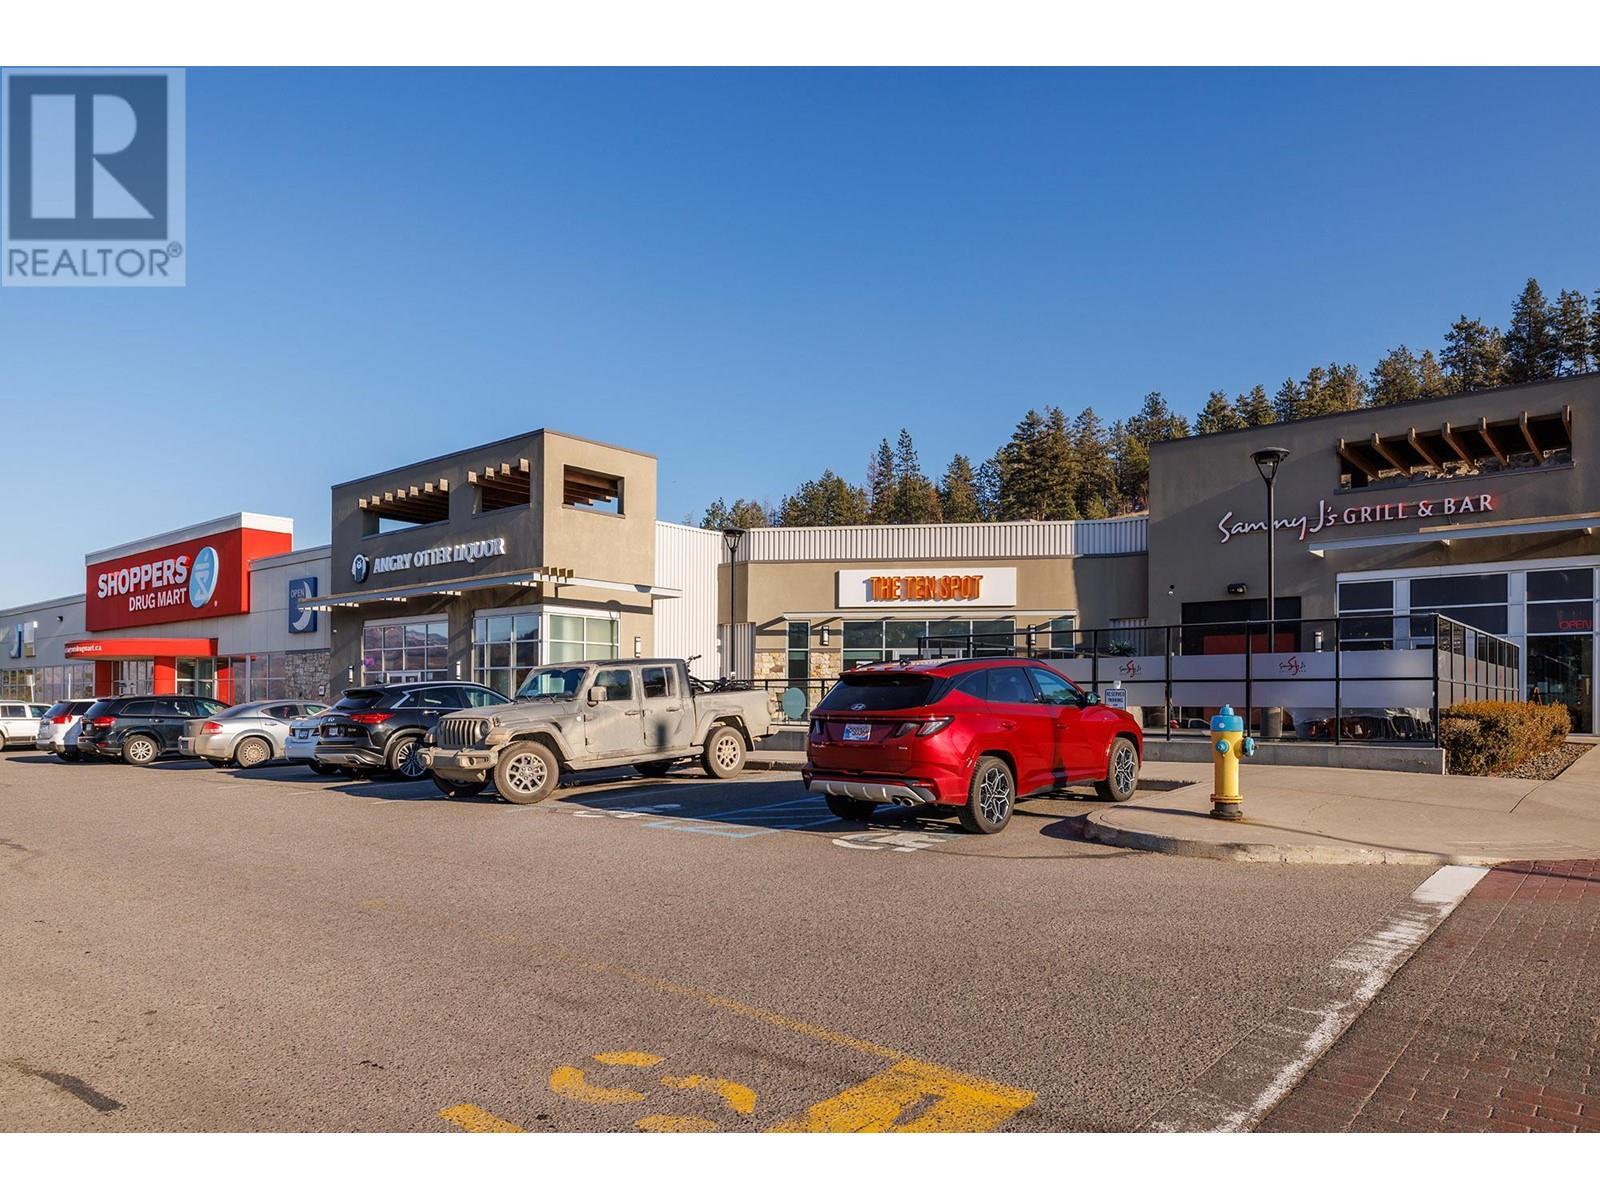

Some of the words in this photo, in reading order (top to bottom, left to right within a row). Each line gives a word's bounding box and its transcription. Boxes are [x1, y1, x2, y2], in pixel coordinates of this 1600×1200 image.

[1218, 511, 1307, 543] Sammy
[1309, 499, 1338, 533] J's
[1343, 502, 1409, 525] GRILL
[1417, 500, 1434, 517] &
[1443, 493, 1494, 516] BAR
[372, 552, 413, 574] ANGRY
[413, 547, 453, 568] OTTER
[453, 537, 507, 563] LIQUOR
[97, 555, 188, 599] SHOPPERS
[870, 576, 901, 600] THE
[904, 575, 936, 600] TEN
[939, 575, 983, 600] SPOT
[128, 592, 156, 612] DRUG
[157, 587, 187, 608] MART
[1559, 619, 1592, 630] OPEN
